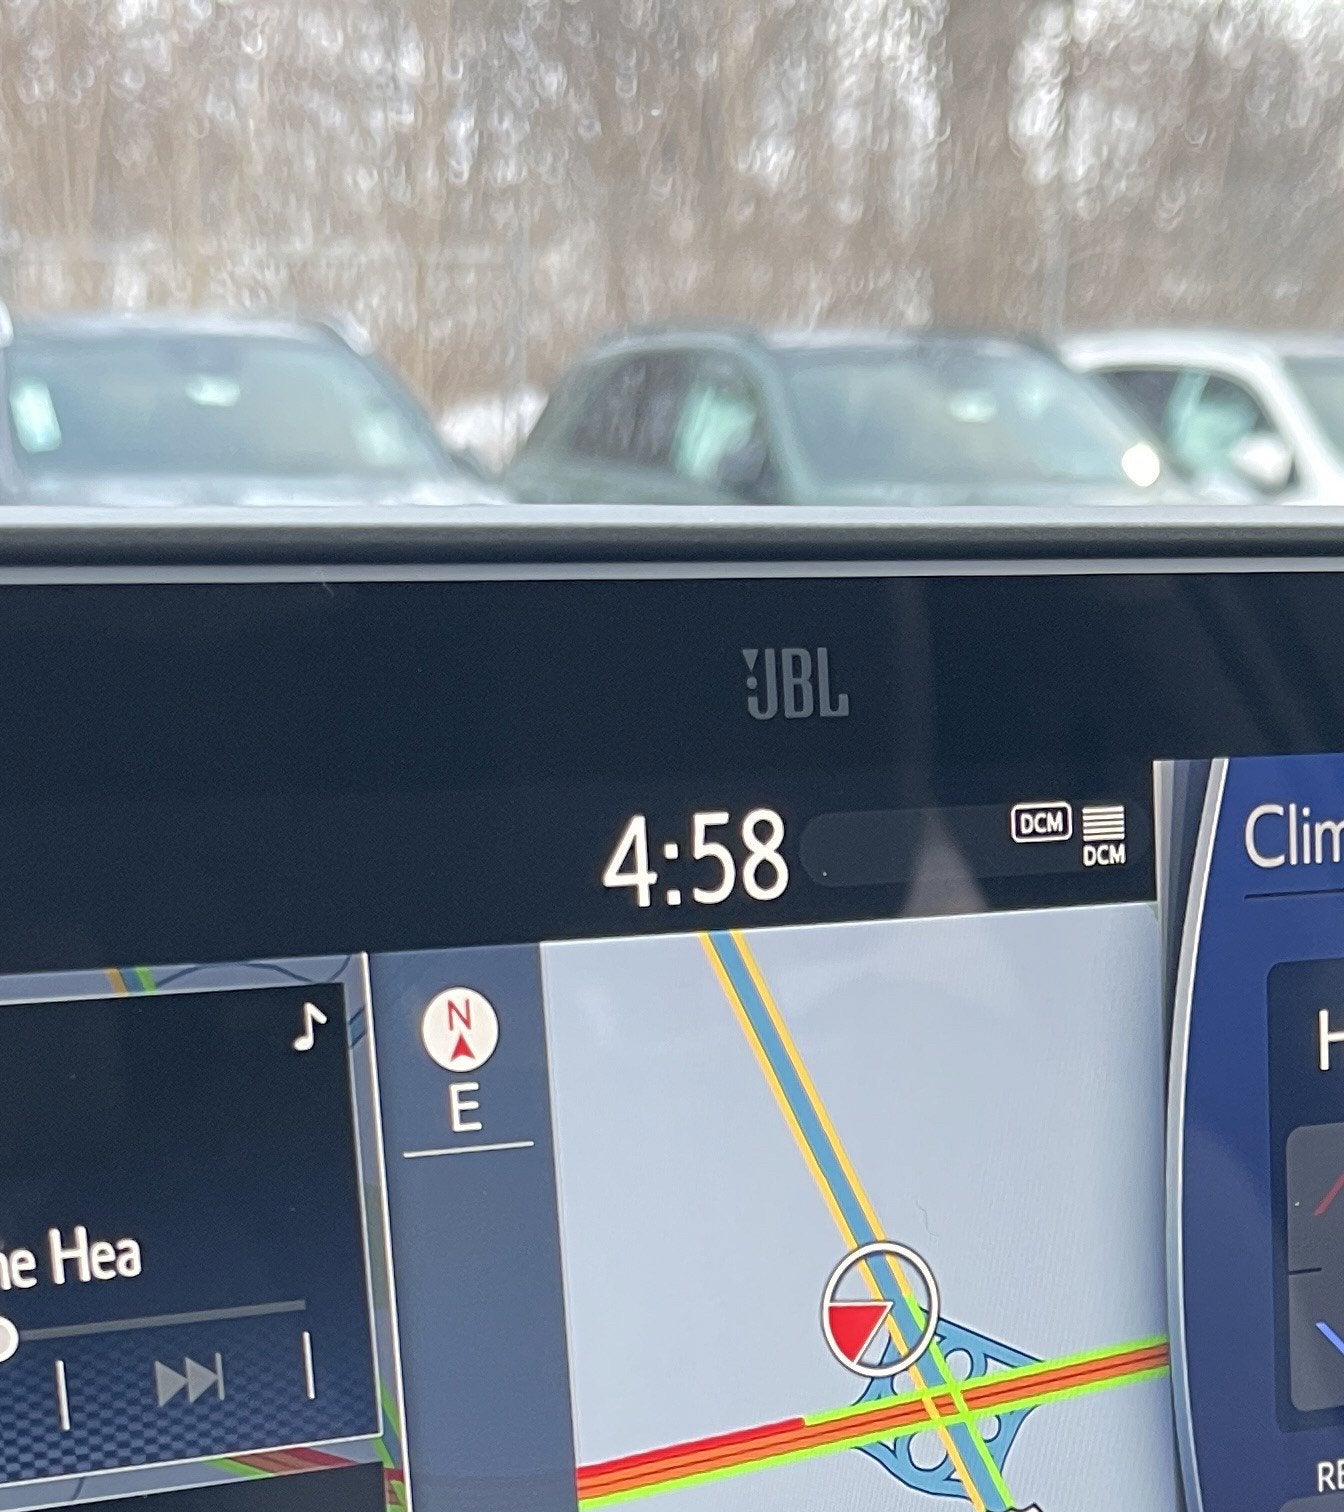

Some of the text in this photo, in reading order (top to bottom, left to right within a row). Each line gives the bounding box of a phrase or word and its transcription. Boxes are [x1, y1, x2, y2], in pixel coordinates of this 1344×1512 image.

[740, 646, 850, 720] JBL
[1019, 810, 1065, 836] DCM
[601, 807, 790, 909] 4:58
[1082, 843, 1127, 867] DCM
[447, 999, 472, 1031] N
[449, 1081, 483, 1133] E
[48, 1225, 142, 1285] Hea
